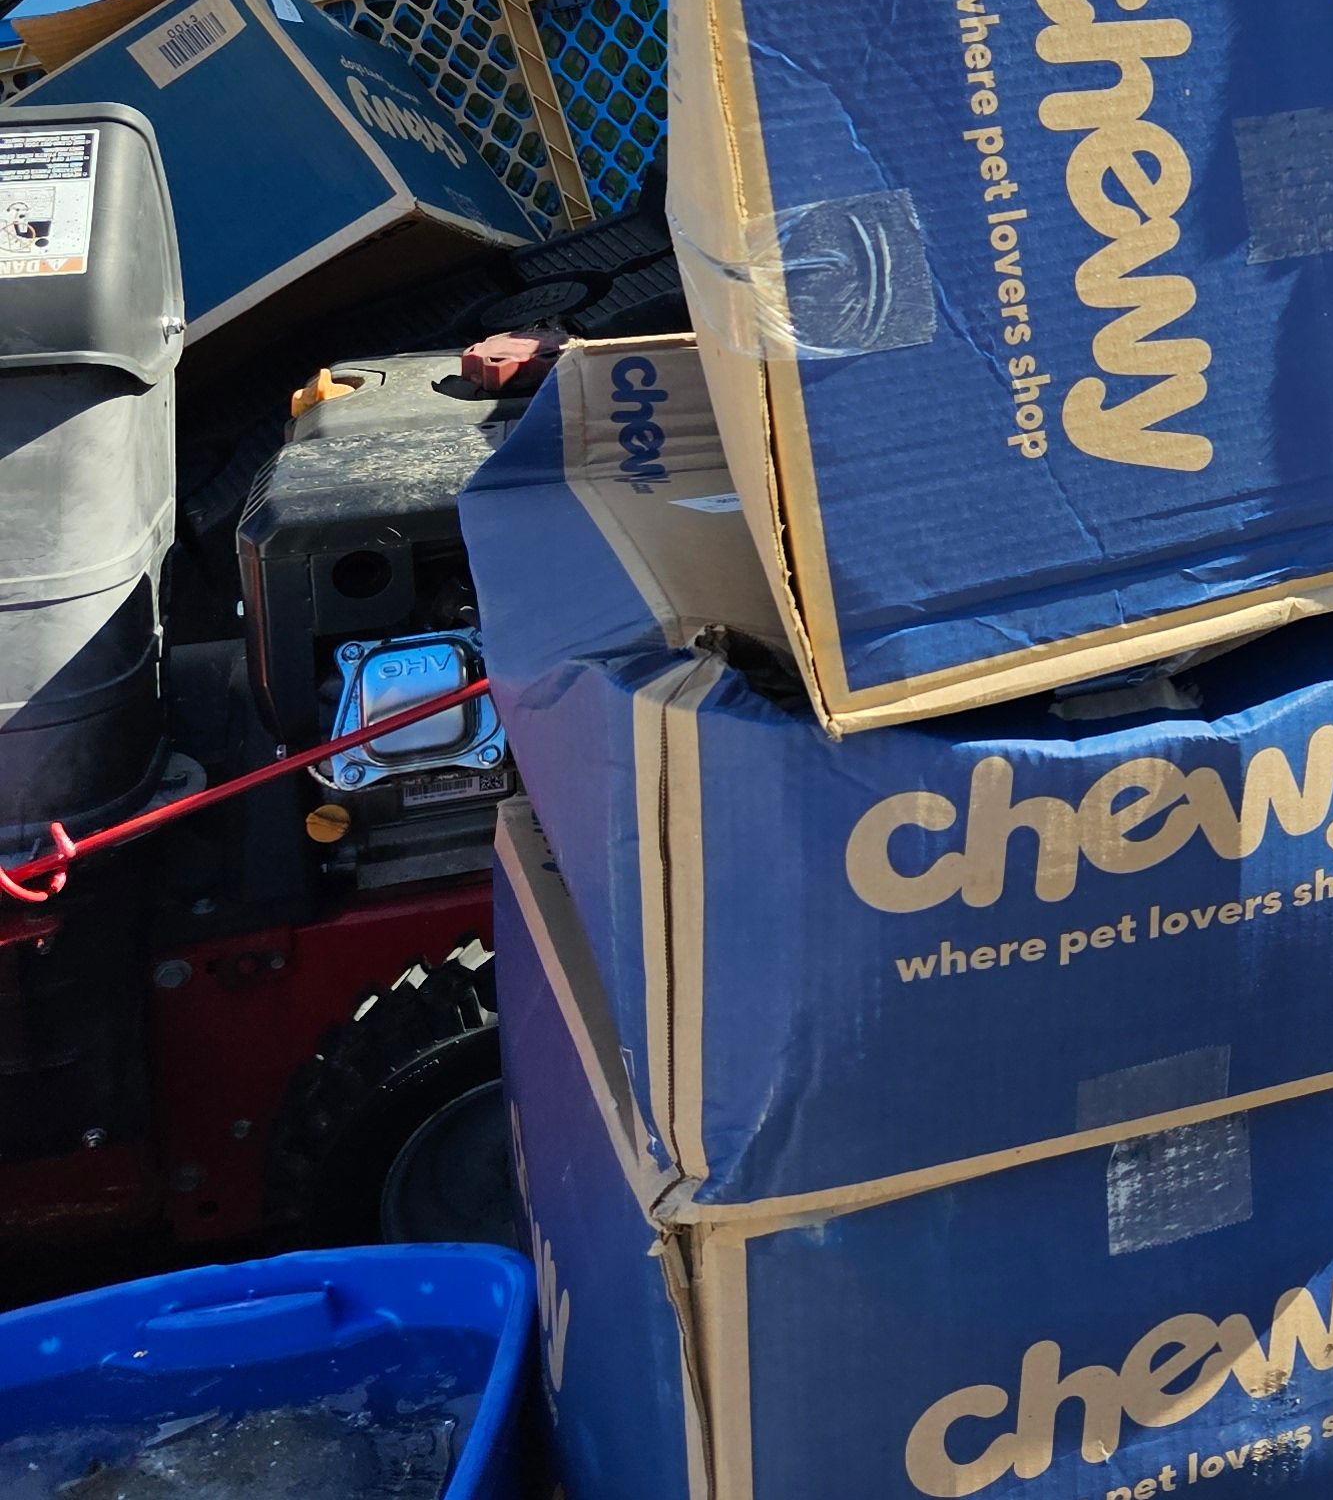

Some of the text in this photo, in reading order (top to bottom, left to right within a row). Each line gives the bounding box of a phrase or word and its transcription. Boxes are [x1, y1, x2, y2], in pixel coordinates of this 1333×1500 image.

[346, 75, 467, 170] chewy
[963, 126, 1018, 202] pet
[987, 209, 1032, 346] lovers
[1008, 355, 1051, 459] shop
[895, 938, 1047, 983] where
[1060, 915, 1137, 965] pet
[1150, 891, 1282, 938] lovers
[1106, 1464, 1177, 1500] pet
